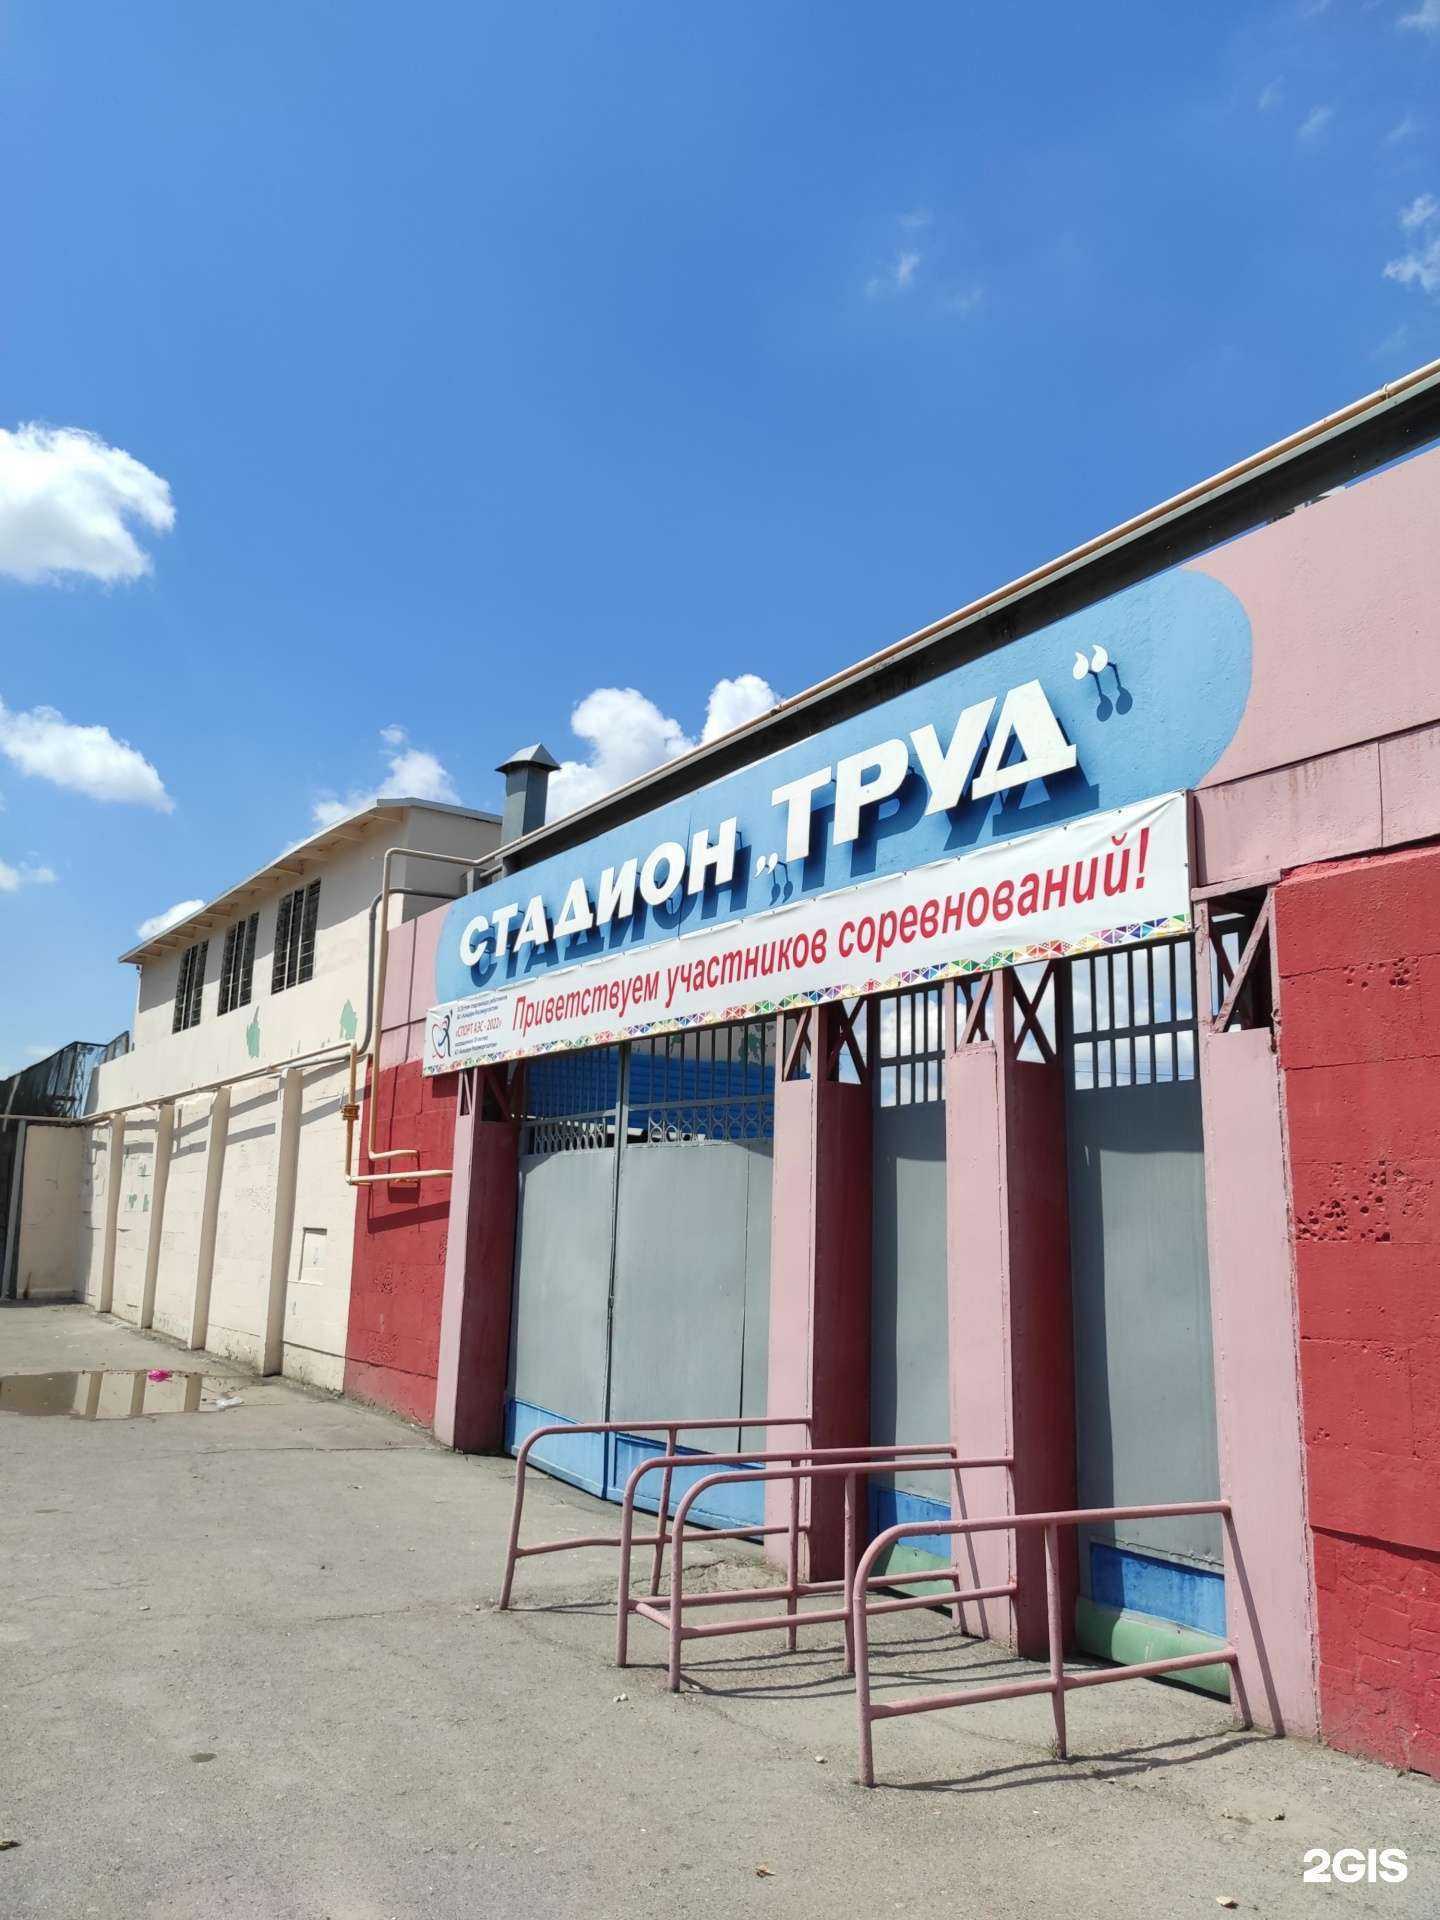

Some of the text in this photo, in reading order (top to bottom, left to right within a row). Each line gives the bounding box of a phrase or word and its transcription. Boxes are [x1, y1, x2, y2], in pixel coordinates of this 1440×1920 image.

[460, 817, 737, 966] СТАДИОН
[512, 827, 1150, 1037] Приветствуем участников соревнований!
